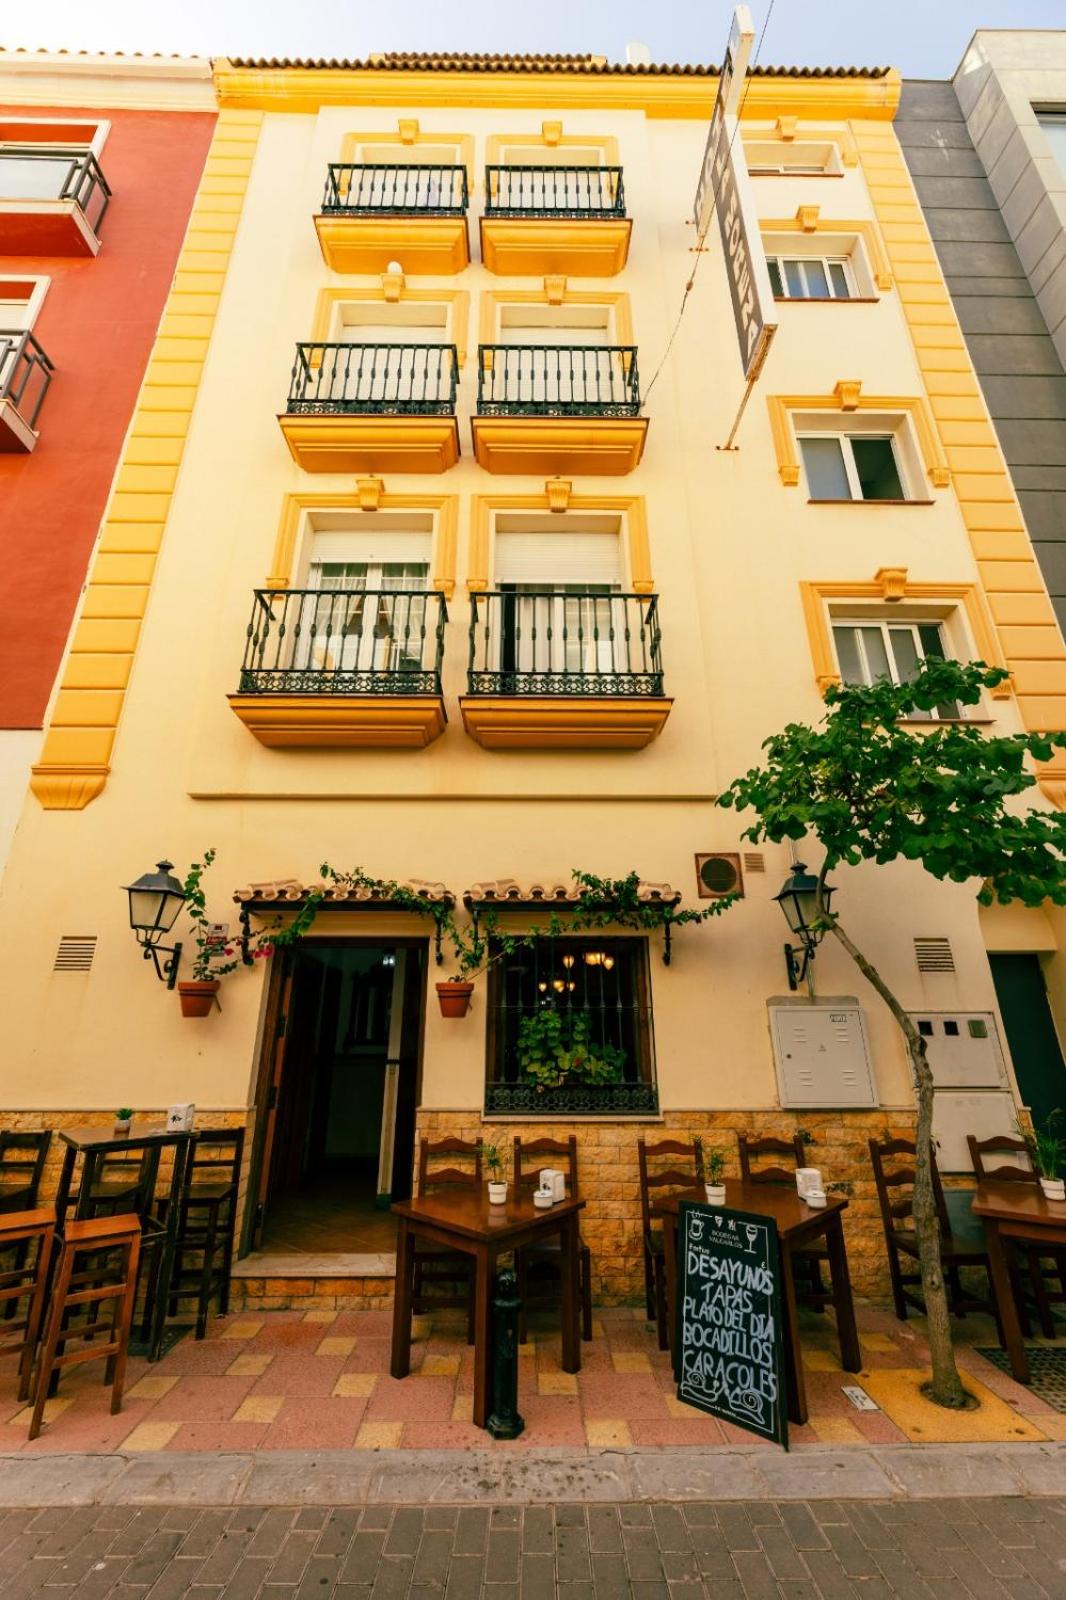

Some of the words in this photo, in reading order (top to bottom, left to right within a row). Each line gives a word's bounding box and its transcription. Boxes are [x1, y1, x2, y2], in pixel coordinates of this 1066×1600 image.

[724, 187, 759, 361] MORENA
[687, 1253, 774, 1296] DESAYUNOS
[683, 1296, 723, 1326] PLATO
[723, 1308, 746, 1332] DEL
[700, 1282, 753, 1313] TAPAS
[683, 1324, 772, 1368] BOCADILLOS
[683, 1351, 777, 1403] CARACOLES
